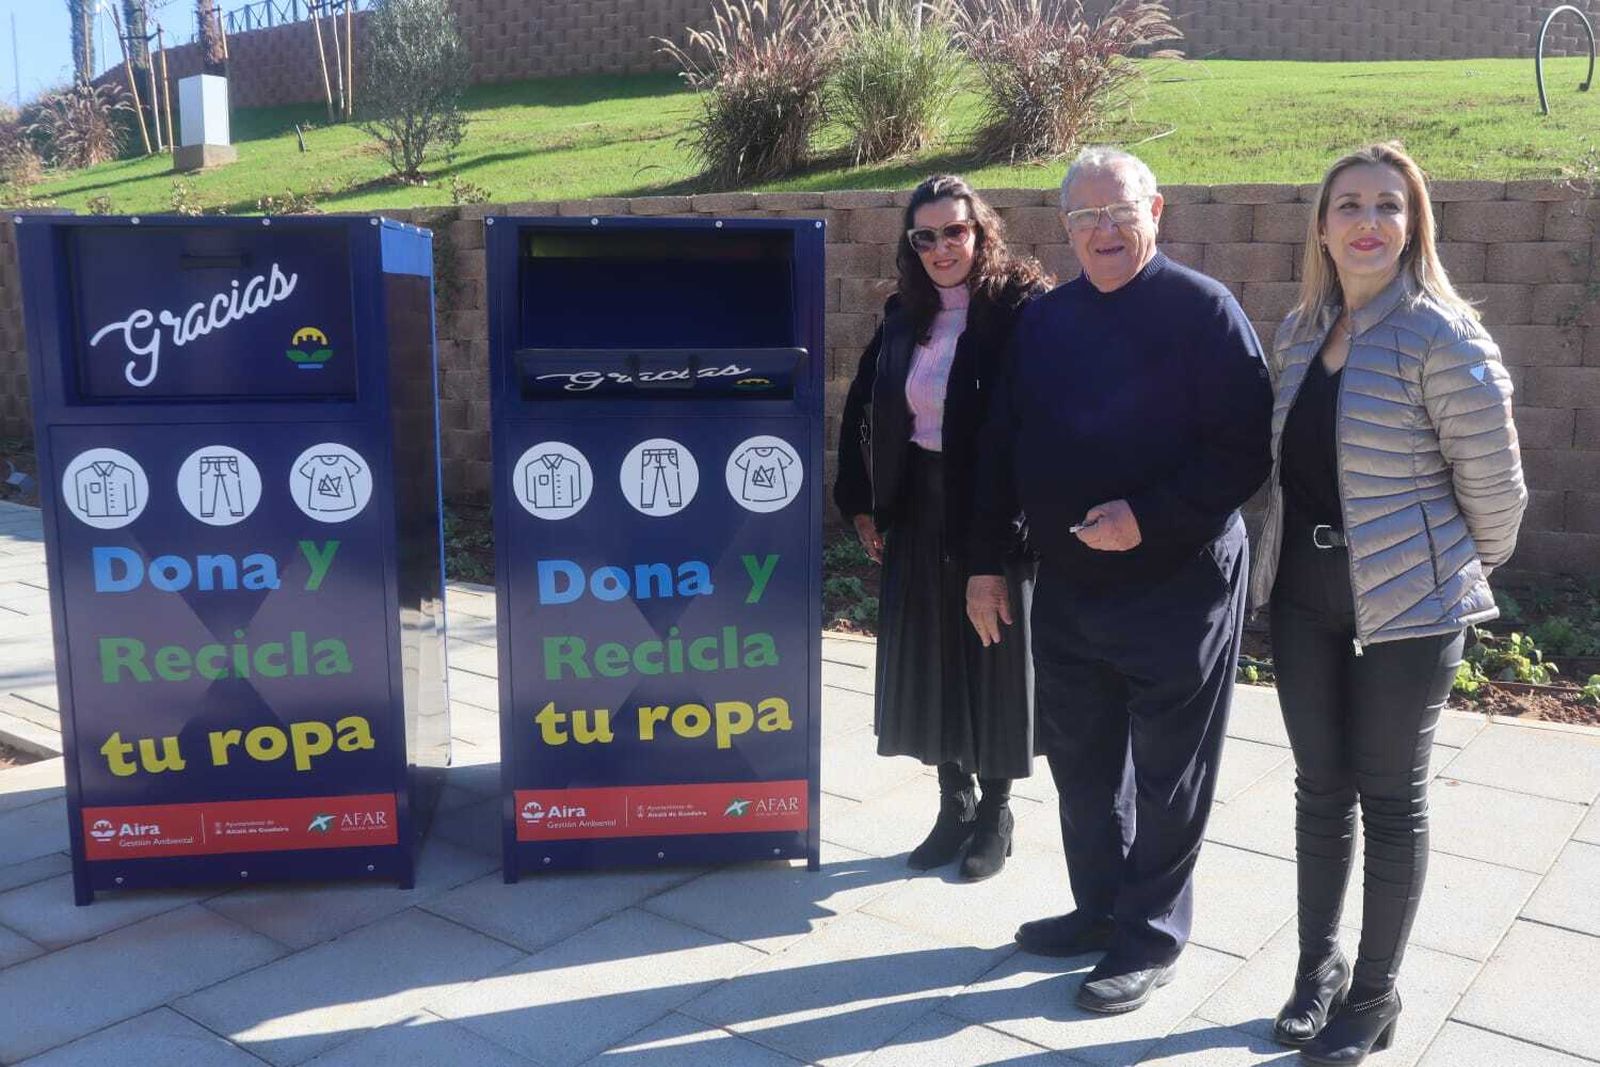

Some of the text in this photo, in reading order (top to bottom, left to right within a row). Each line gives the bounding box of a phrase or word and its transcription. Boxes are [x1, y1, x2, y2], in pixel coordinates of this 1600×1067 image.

[90, 262, 298, 387] Gracias
[92, 540, 338, 592] Dona y
[538, 553, 779, 605] Dona y
[99, 631, 353, 684] Recicla
[543, 626, 781, 681] Recicla
[101, 716, 375, 777] tu ropa
[536, 697, 793, 750] tu ropa
[118, 822, 160, 837] Aira
[340, 811, 387, 826] AFAR
[547, 804, 587, 818] Aira
[578, 819, 617, 827] Ambiental
[755, 796, 799, 812] AFAR
[153, 836, 194, 846] Ambiental
